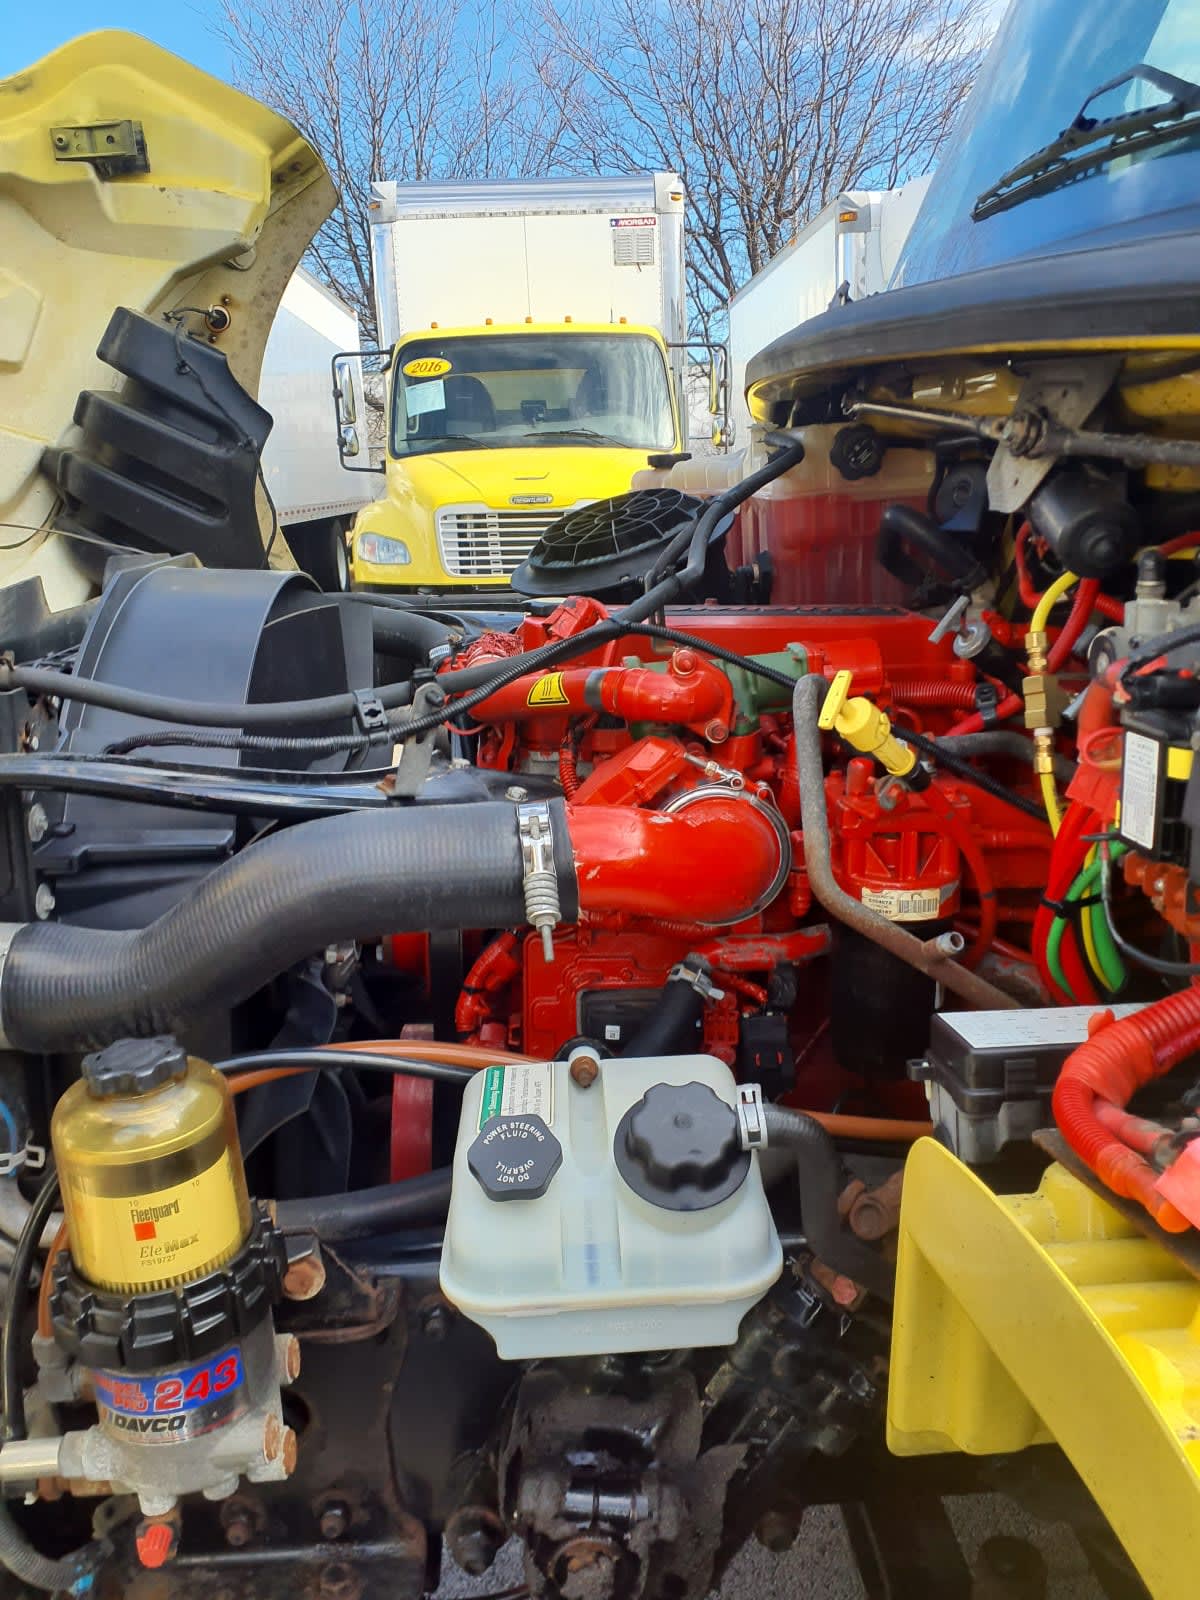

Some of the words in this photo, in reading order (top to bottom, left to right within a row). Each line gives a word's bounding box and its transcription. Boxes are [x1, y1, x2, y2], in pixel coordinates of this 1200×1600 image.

[618, 218, 655, 226] MORGAN
[411, 361, 442, 373] 2016
[483, 1124, 508, 1145] POWER
[510, 1122, 545, 1142] STEERING
[500, 1130, 528, 1140] FLUID
[495, 1160, 535, 1175] OVERFILL
[497, 1174, 515, 1183] NOT
[517, 1173, 530, 1182] DO
[130, 1199, 180, 1223] Fleetguard
[153, 1356, 238, 1412] 243
[114, 1413, 187, 1432] DAVCO
